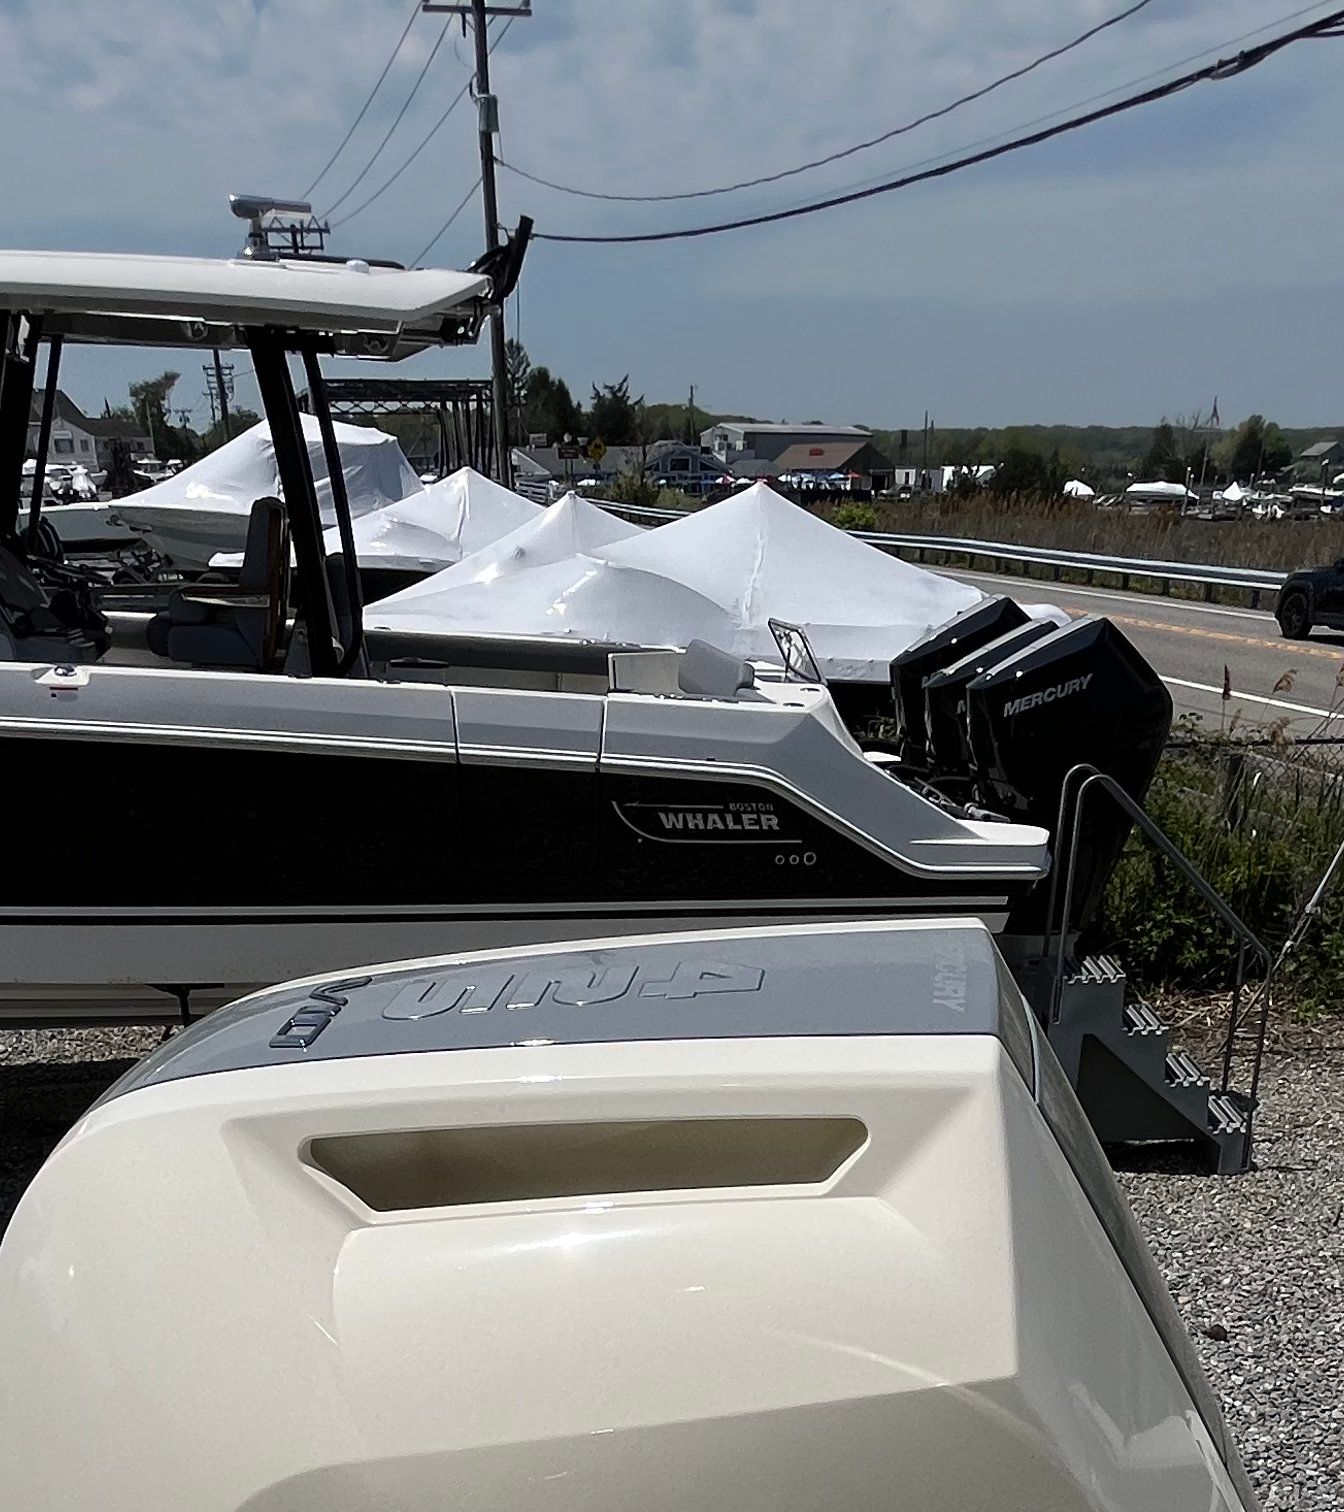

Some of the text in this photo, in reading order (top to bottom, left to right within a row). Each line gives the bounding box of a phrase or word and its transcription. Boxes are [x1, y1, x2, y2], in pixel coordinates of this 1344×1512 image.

[1003, 672, 1093, 718] MERCURY
[658, 812, 780, 830] WHALER
[729, 802, 774, 812] BOSTON
[382, 960, 766, 1021] 425
